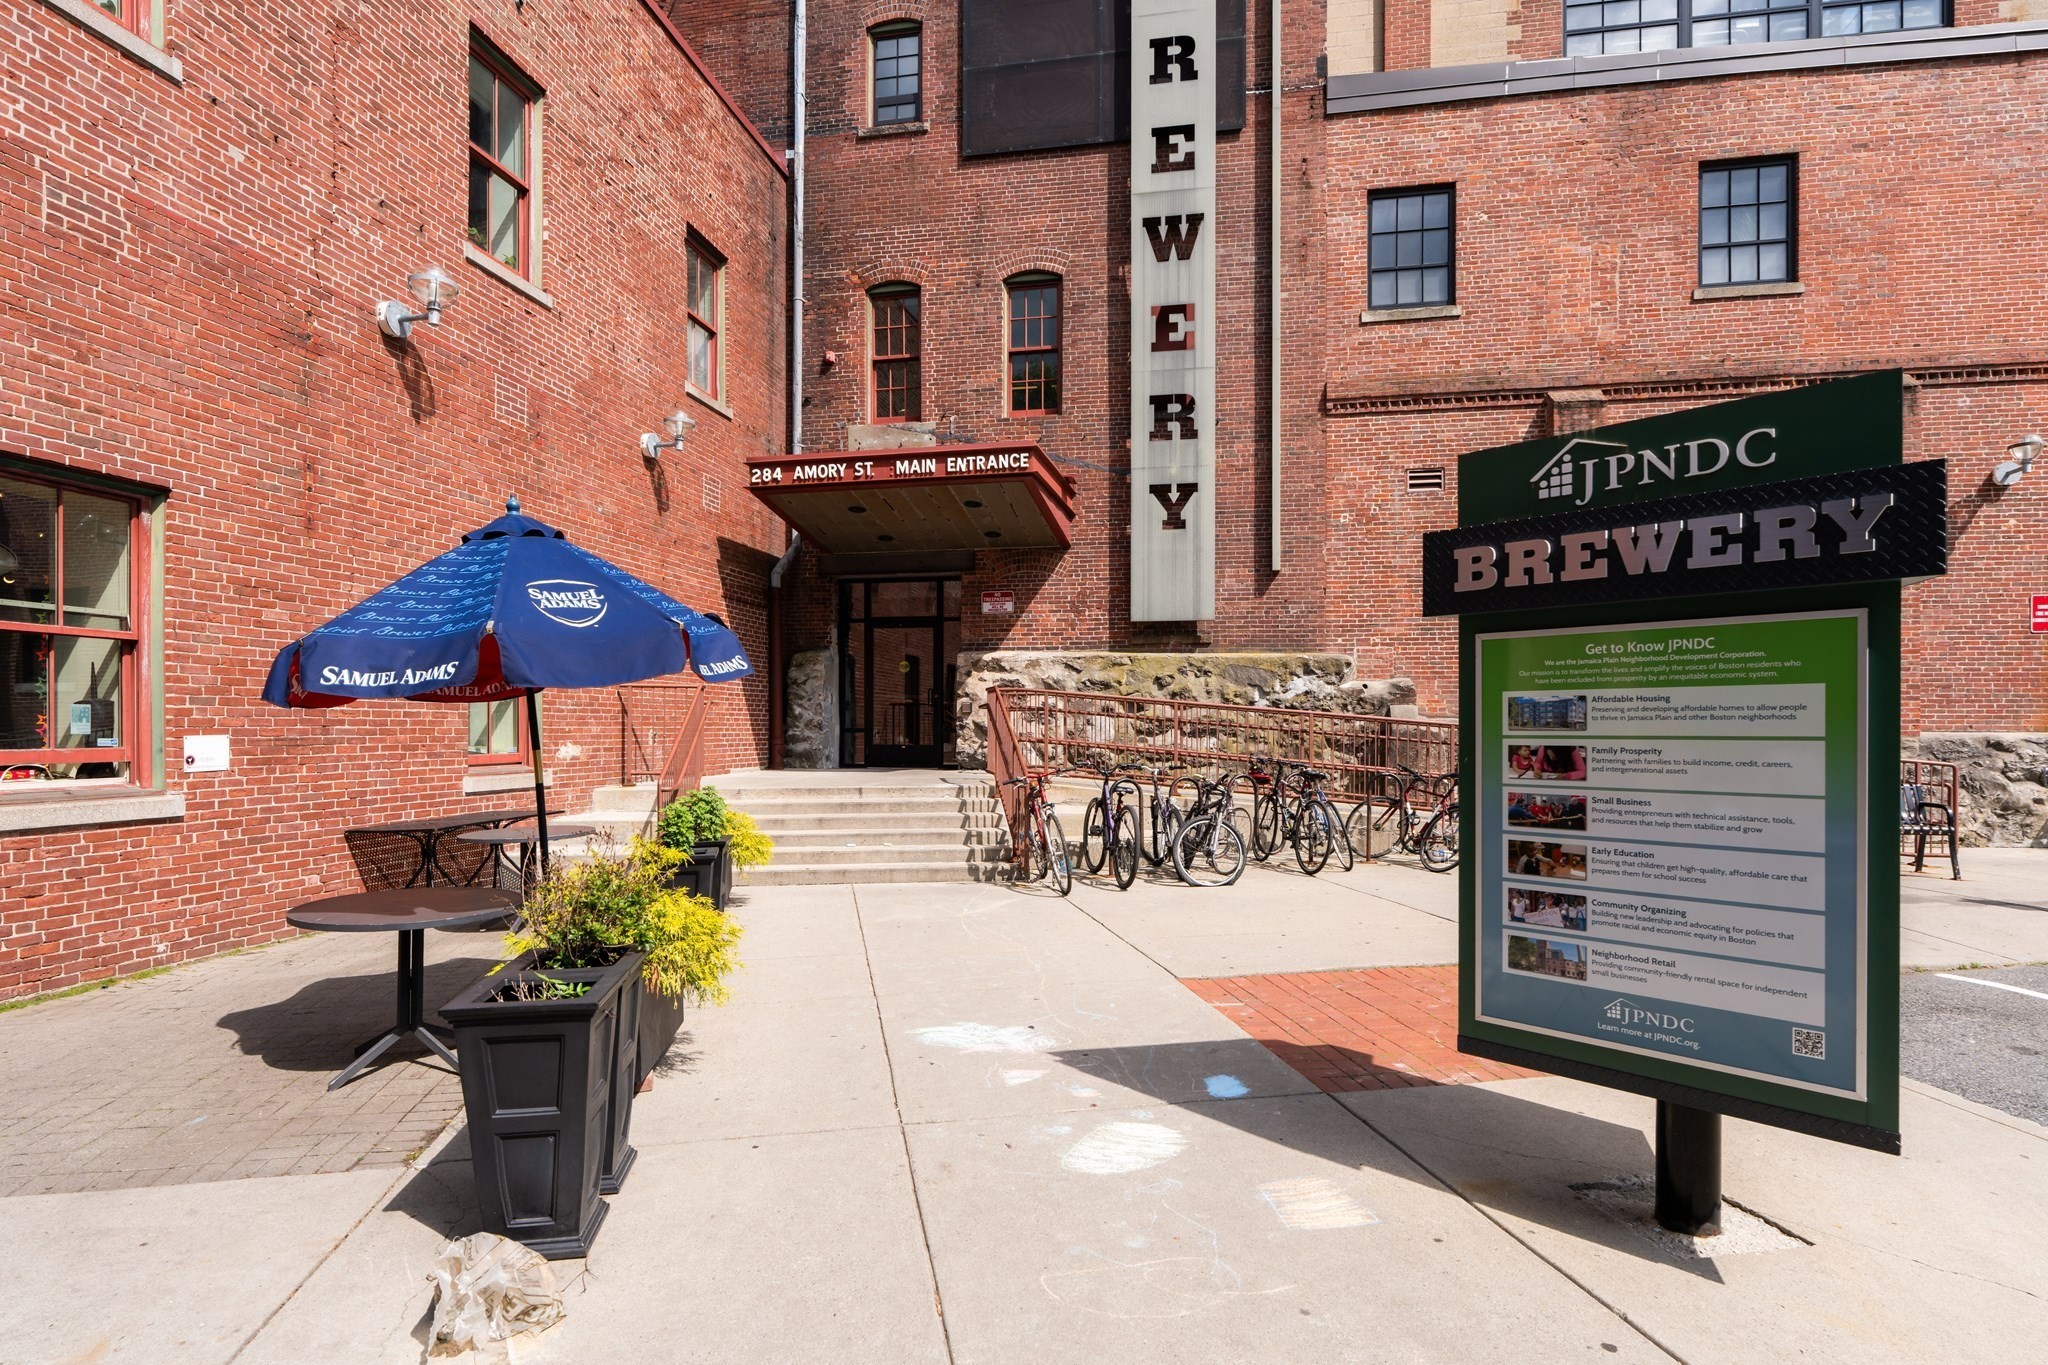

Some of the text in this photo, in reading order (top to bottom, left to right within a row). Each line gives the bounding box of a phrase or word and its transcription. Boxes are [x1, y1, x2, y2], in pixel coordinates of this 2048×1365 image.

[752, 453, 1029, 483] 284 AMORY ST. MAIN ENTRANCE
[1576, 428, 1777, 504] JPNDC
[1454, 492, 1894, 593] BREWERY
[528, 588, 604, 600] SAMUEL
[540, 599, 602, 609] ADAMS
[1586, 637, 1715, 654] Get to Know JPNDC
[710, 655, 748, 674] ADAMS
[320, 666, 398, 686] SAMUEL
[400, 661, 459, 684] ADAMS
[1636, 694, 1670, 703] Housing
[1640, 705, 1678, 713] developing
[1779, 703, 1807, 712] people
[1737, 713, 1796, 721] neighborhoods
[1591, 746, 1662, 756] Family Prosperity
[1591, 757, 1626, 765] Partnering
[1591, 807, 1622, 816] Providing
[1728, 815, 1770, 823] assistance,
[1654, 820, 1670, 829] help
[1591, 847, 1654, 858] Early Education
[1591, 857, 1620, 868] Ensuring
[1636, 861, 1665, 869] children
[1680, 864, 1726, 876] high-quality,
[1728, 869, 1769, 878] affordable
[1591, 899, 1686, 918] Community Organizing
[1591, 909, 1618, 920] Building
[1635, 914, 1672, 926] leadership
[1689, 921, 1730, 933] advocating
[1745, 928, 1775, 937] policies
[1656, 928, 1691, 936] economic
[1693, 932, 1717, 941] equity
[1728, 934, 1756, 944] Boston
[1591, 949, 1675, 966] Neighborhood Retail
[1591, 959, 1622, 972] Providing
[1754, 984, 1807, 997] independent
[1610, 971, 1647, 982] businesses
[1622, 1007, 1694, 1032] JPNDC
[1597, 1021, 1619, 1032] Learn
[1620, 1028, 1642, 1036] more
[1653, 1031, 1700, 1048] JPNDC.org.
